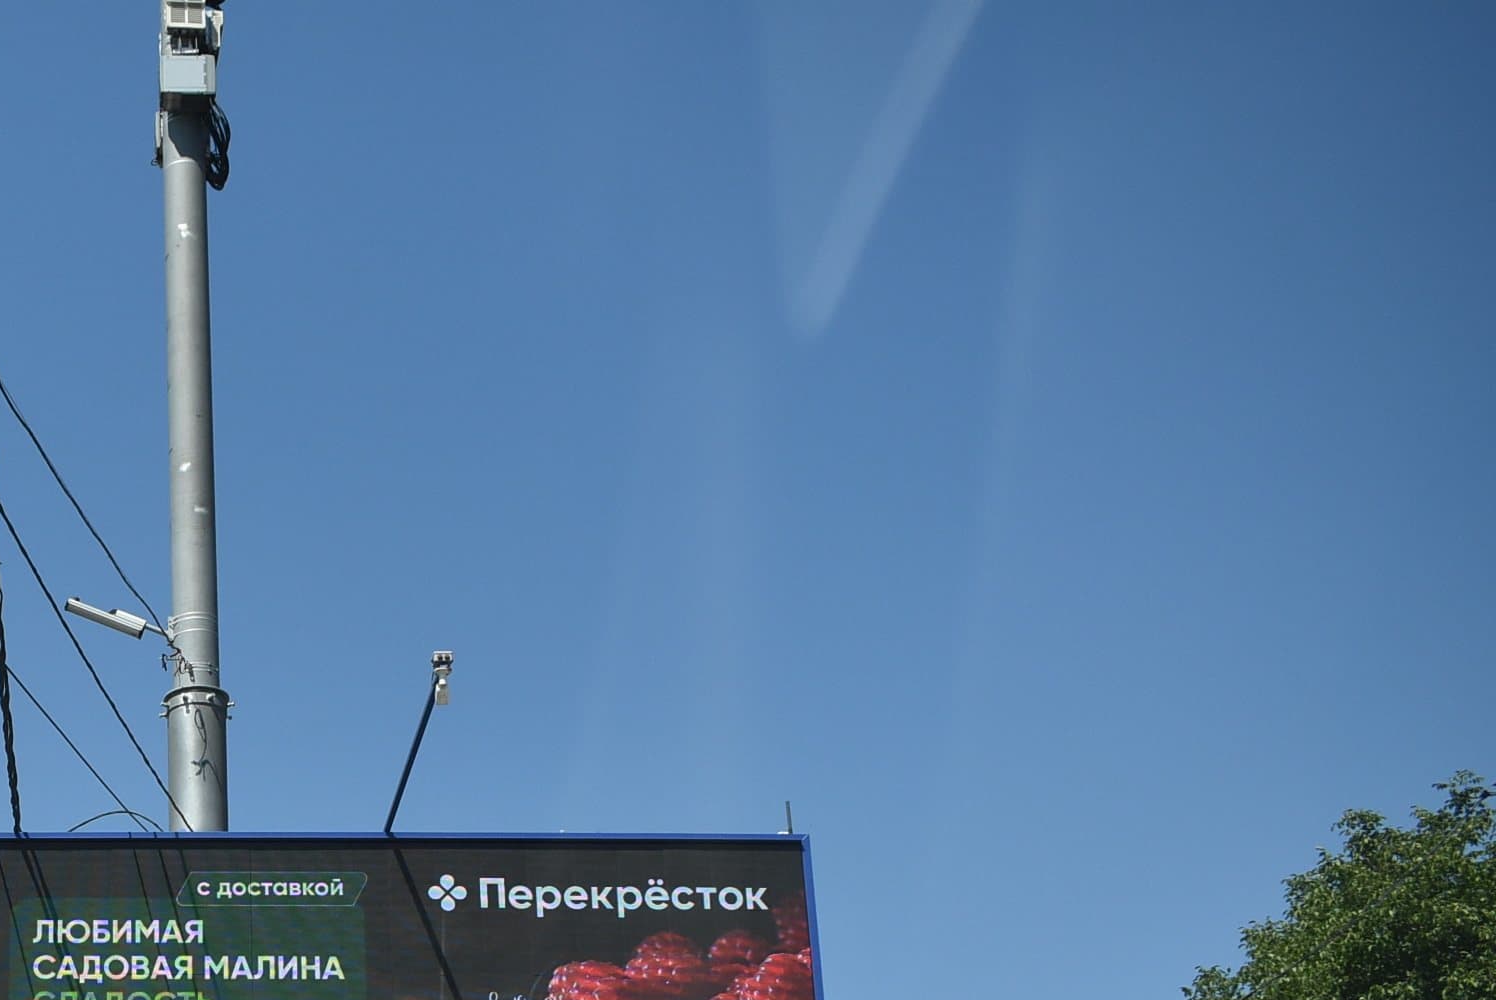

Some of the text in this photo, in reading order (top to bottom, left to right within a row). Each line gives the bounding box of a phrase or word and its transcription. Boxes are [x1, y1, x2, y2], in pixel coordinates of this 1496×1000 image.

[197, 877, 344, 898] с доставкой
[479, 877, 769, 918] Перекрёсток
[32, 919, 204, 944] ЛЮБИМАЯ
[32, 955, 345, 984] САДОВАЯ МАЛИНА
